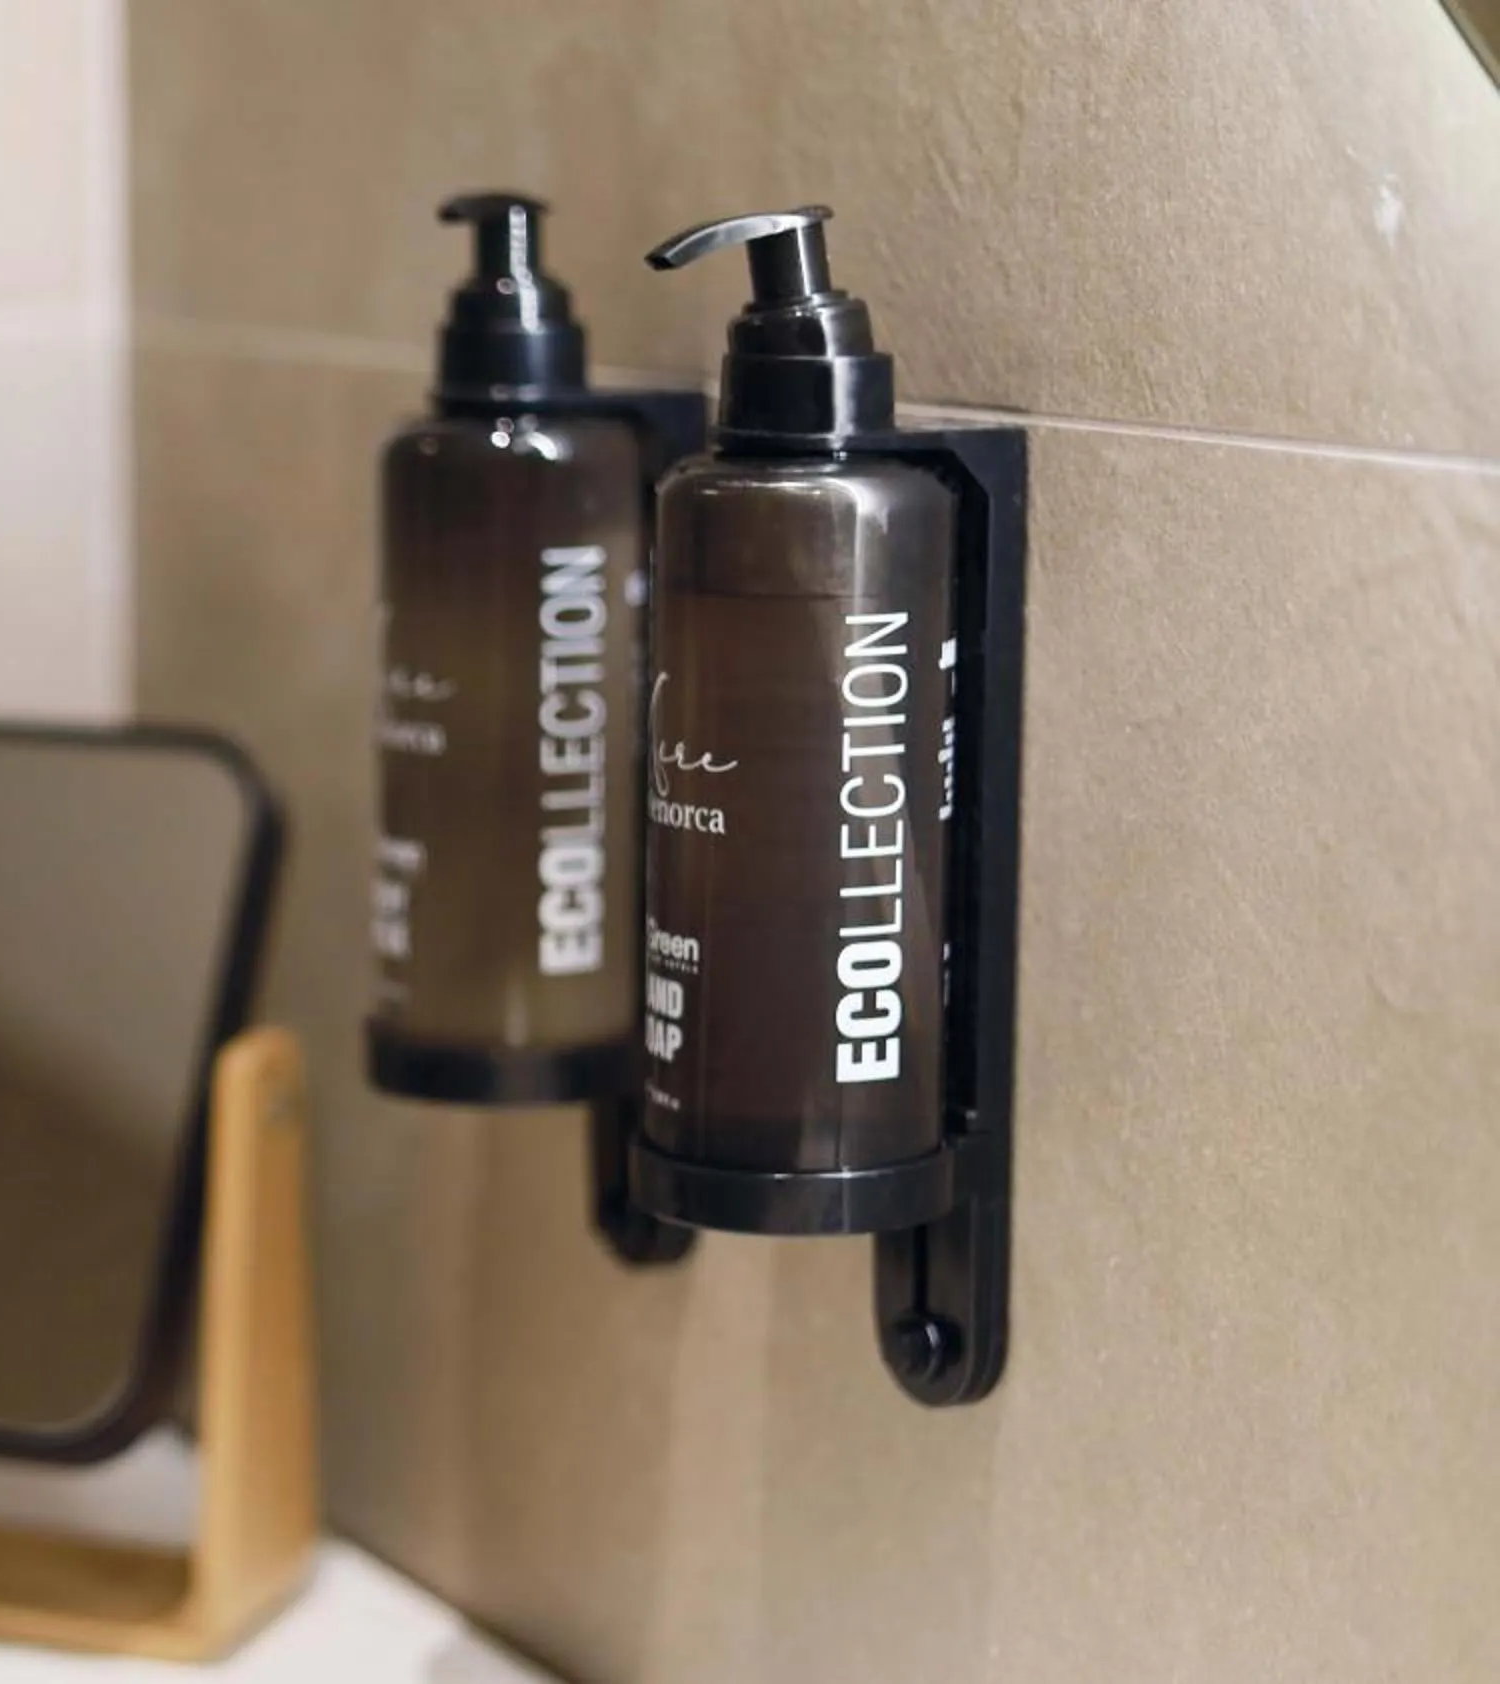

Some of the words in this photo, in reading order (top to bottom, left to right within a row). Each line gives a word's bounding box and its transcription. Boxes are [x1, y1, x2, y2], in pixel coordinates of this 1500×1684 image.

[538, 545, 606, 976] ECOLLECTION
[836, 612, 909, 1083] ECOLLECTION
[646, 1012, 683, 1063] OAP
[647, 972, 684, 1020] AND
